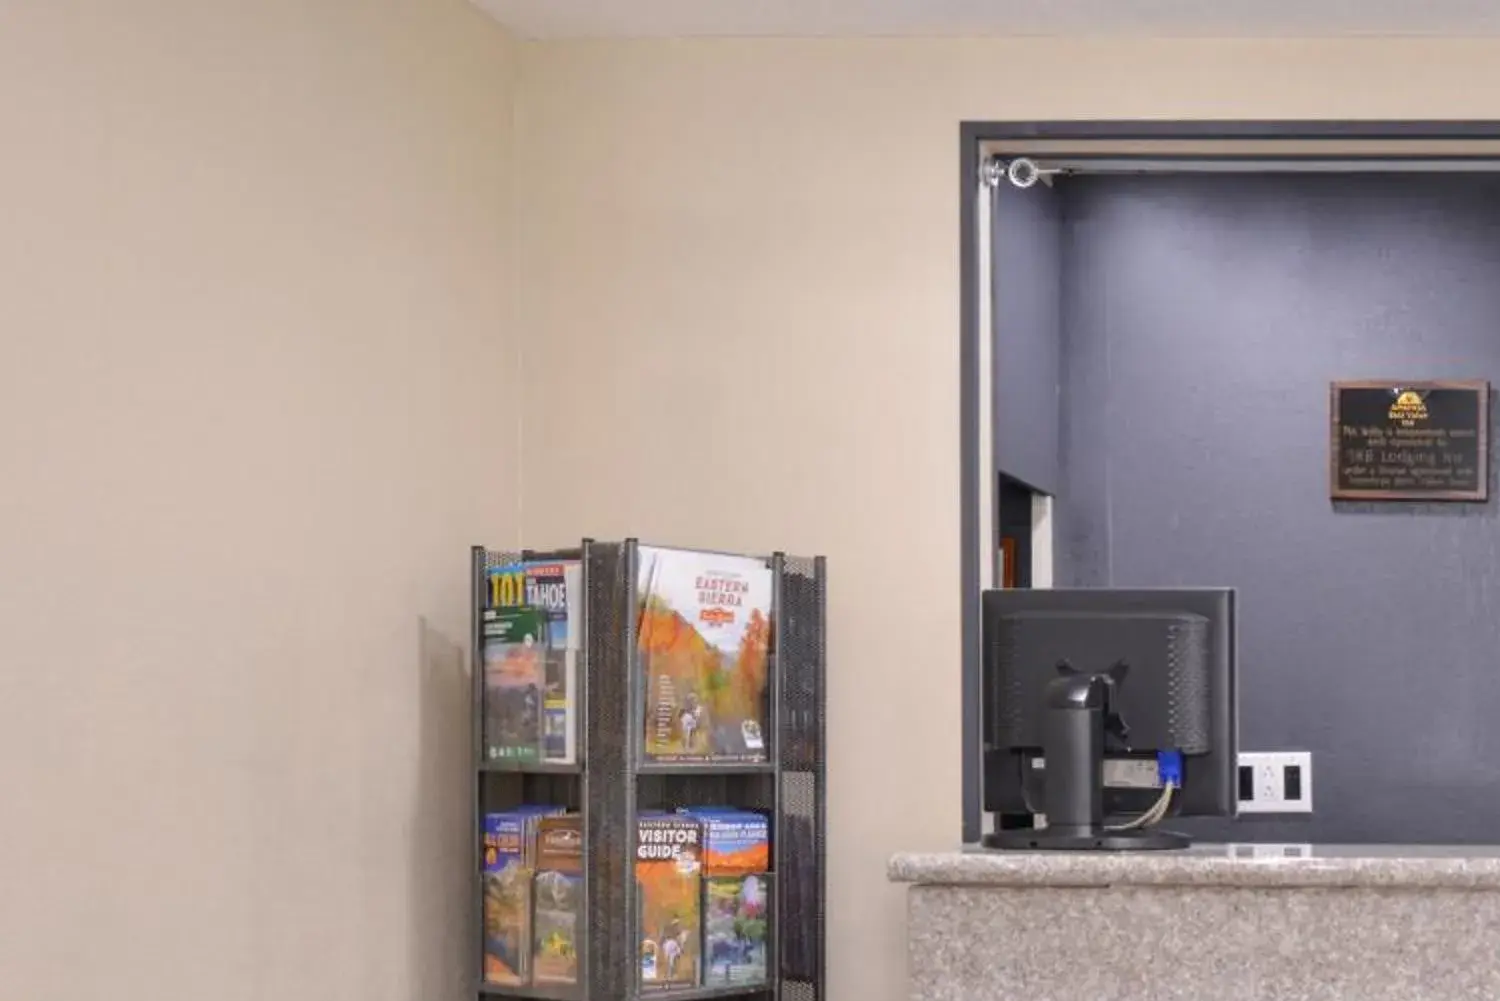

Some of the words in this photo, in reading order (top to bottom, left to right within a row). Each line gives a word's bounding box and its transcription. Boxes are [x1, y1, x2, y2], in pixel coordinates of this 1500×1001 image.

[695, 576, 749, 593] EASTERN
[526, 582, 566, 608] TAHOE
[639, 829, 697, 843] VISITOR
[637, 844, 681, 859] GUIDE
